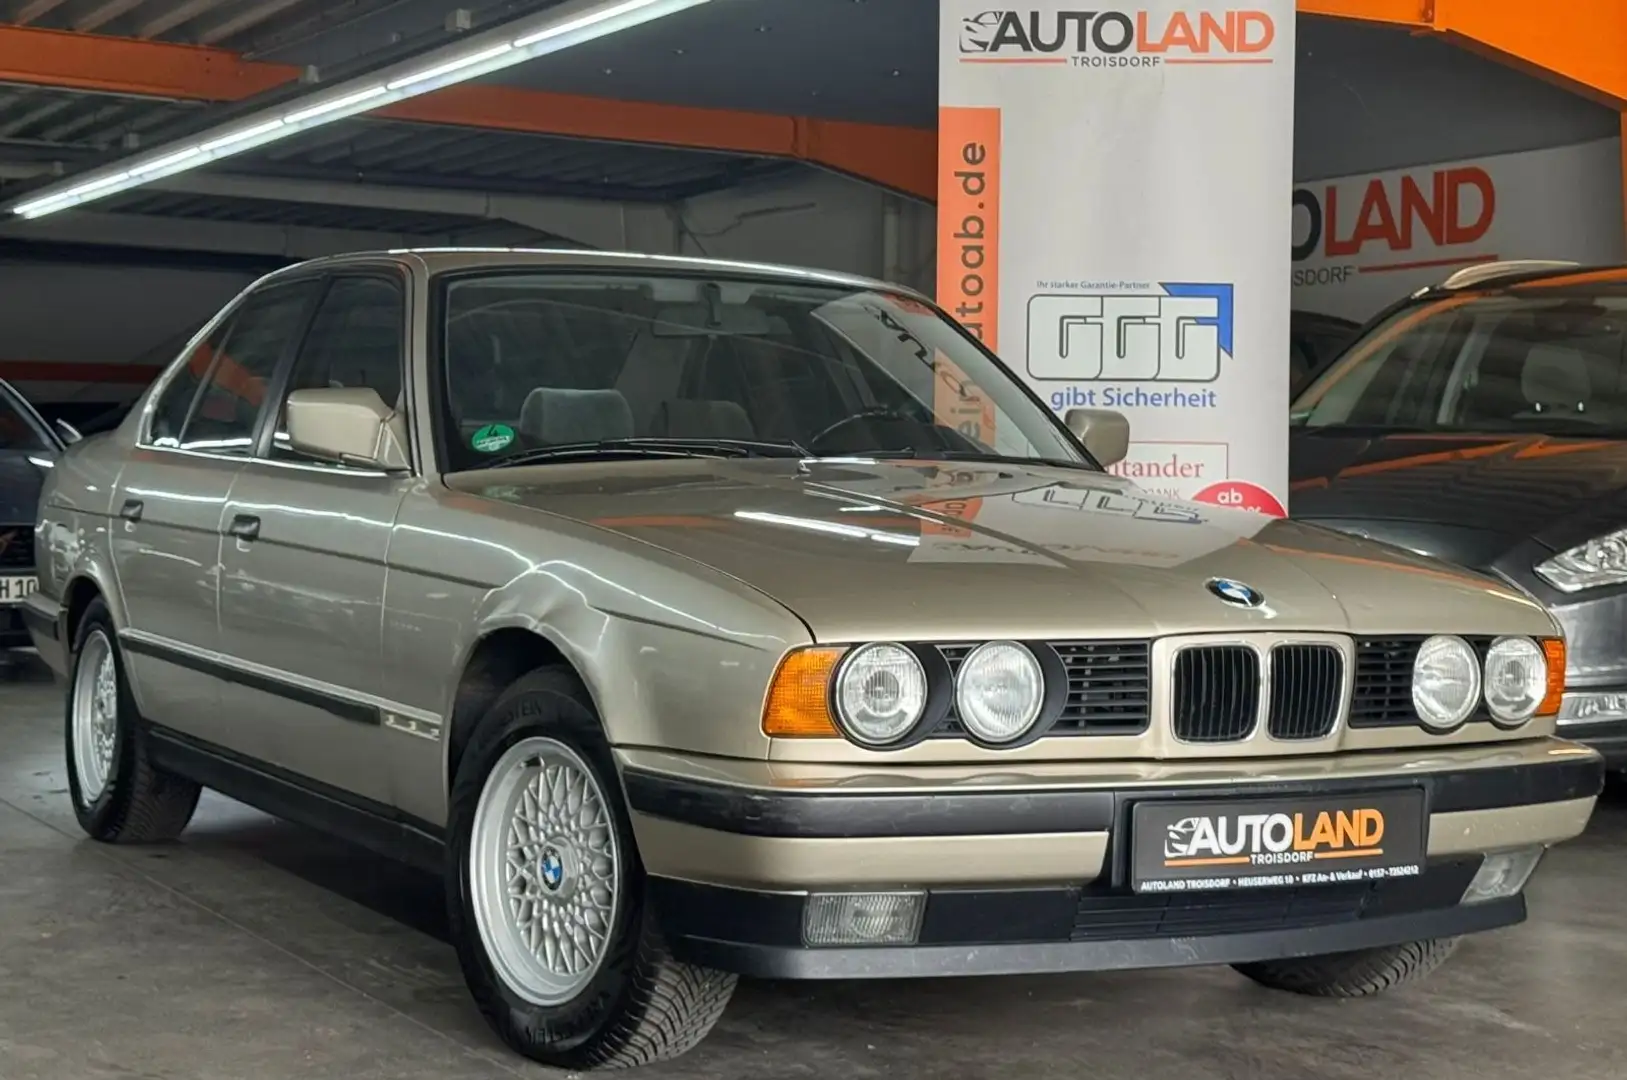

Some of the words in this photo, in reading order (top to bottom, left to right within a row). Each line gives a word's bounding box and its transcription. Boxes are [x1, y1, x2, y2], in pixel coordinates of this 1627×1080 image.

[988, 11, 1275, 53] AUTOLAND
[1071, 56, 1161, 67] TROISDORF
[1050, 280, 1079, 289] starker
[1080, 280, 1150, 290] Garantie-Partner
[1050, 388, 1096, 411] gibt
[1102, 387, 1217, 408] Sicherheit
[1217, 488, 1243, 504] ab
[1184, 808, 1385, 856] AUTOLAND
[1250, 851, 1314, 866] TROISDORF
[1140, 880, 1185, 891] AUTOLAND
[1186, 878, 1231, 889] TROISDORF
